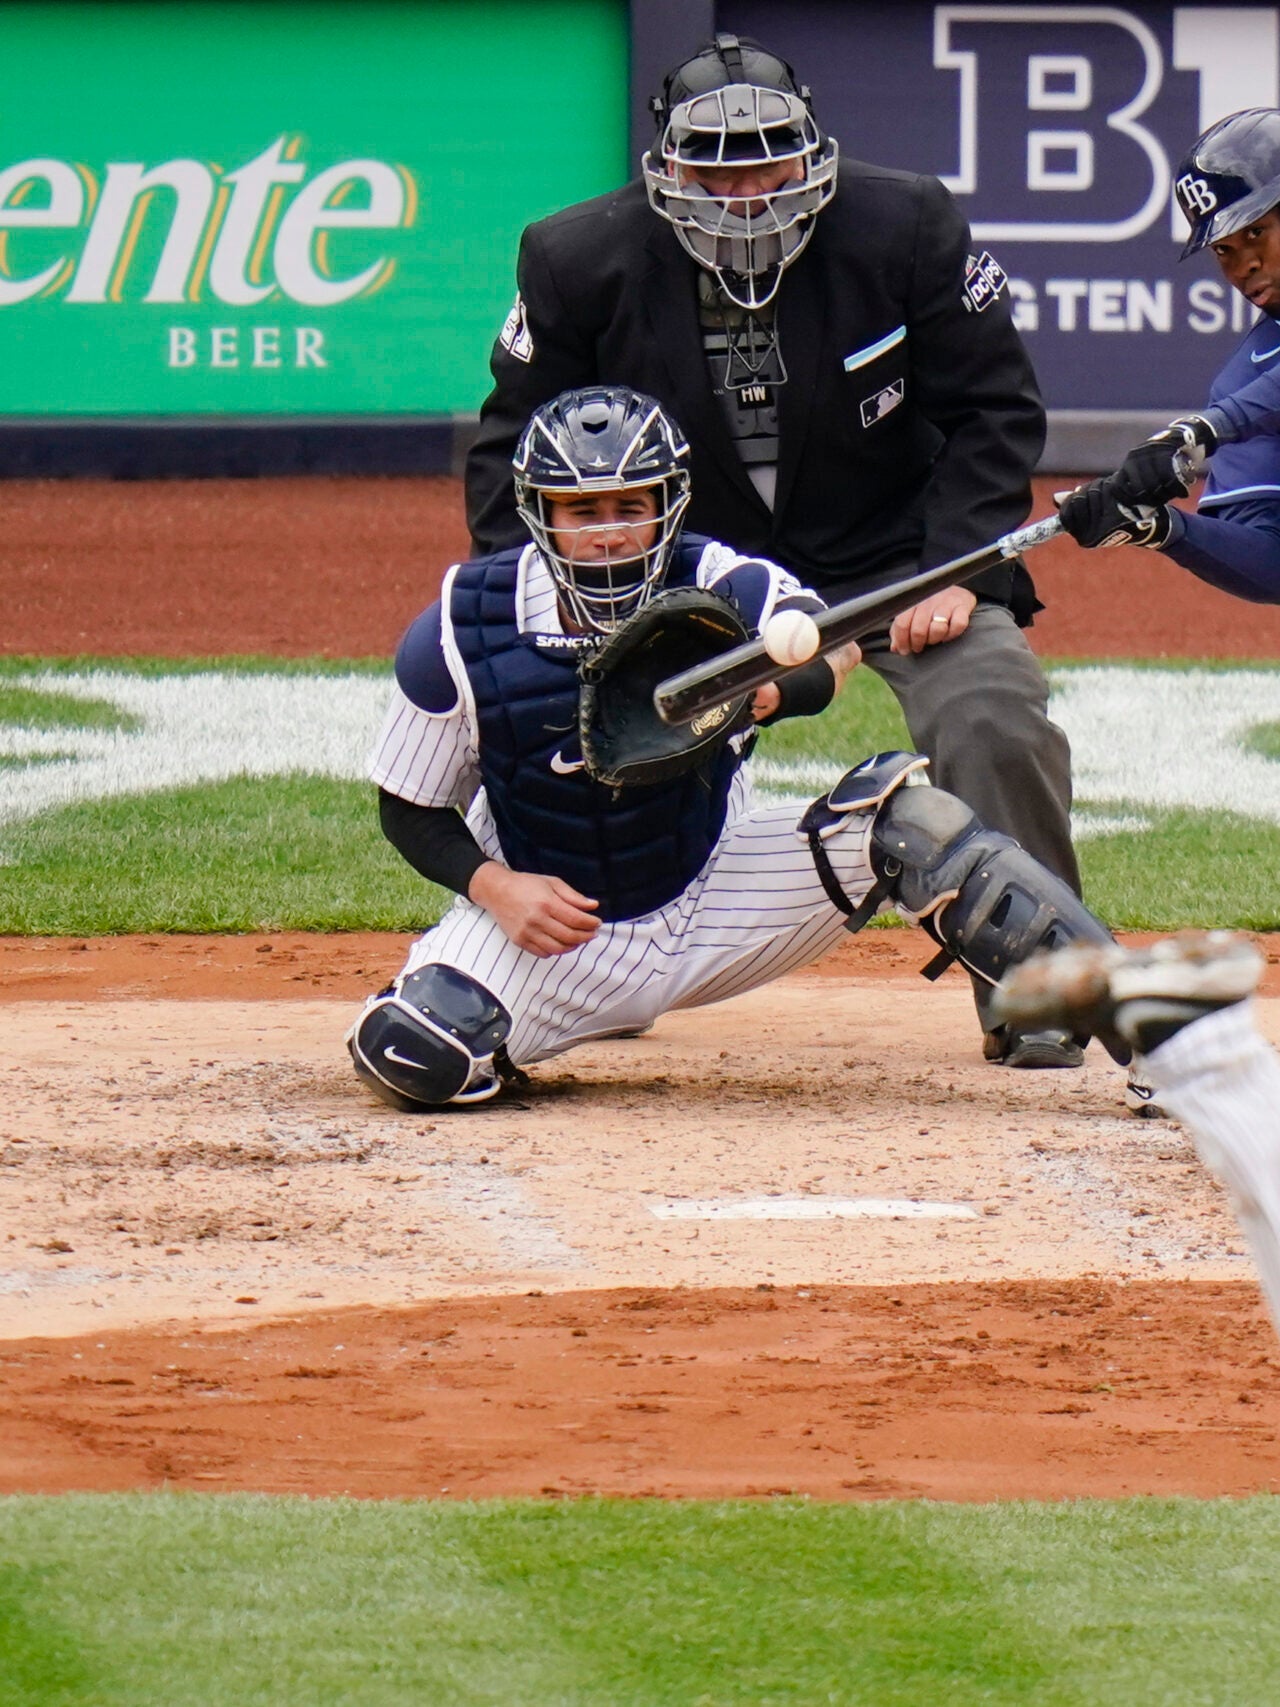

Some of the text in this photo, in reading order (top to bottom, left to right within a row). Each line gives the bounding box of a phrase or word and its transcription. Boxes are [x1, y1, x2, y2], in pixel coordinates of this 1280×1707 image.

[1176, 173, 1217, 215] TB
[0, 136, 418, 307] ente
[1046, 278, 1172, 332] TEN
[168, 326, 327, 368] BEER
[741, 386, 766, 402] HW
